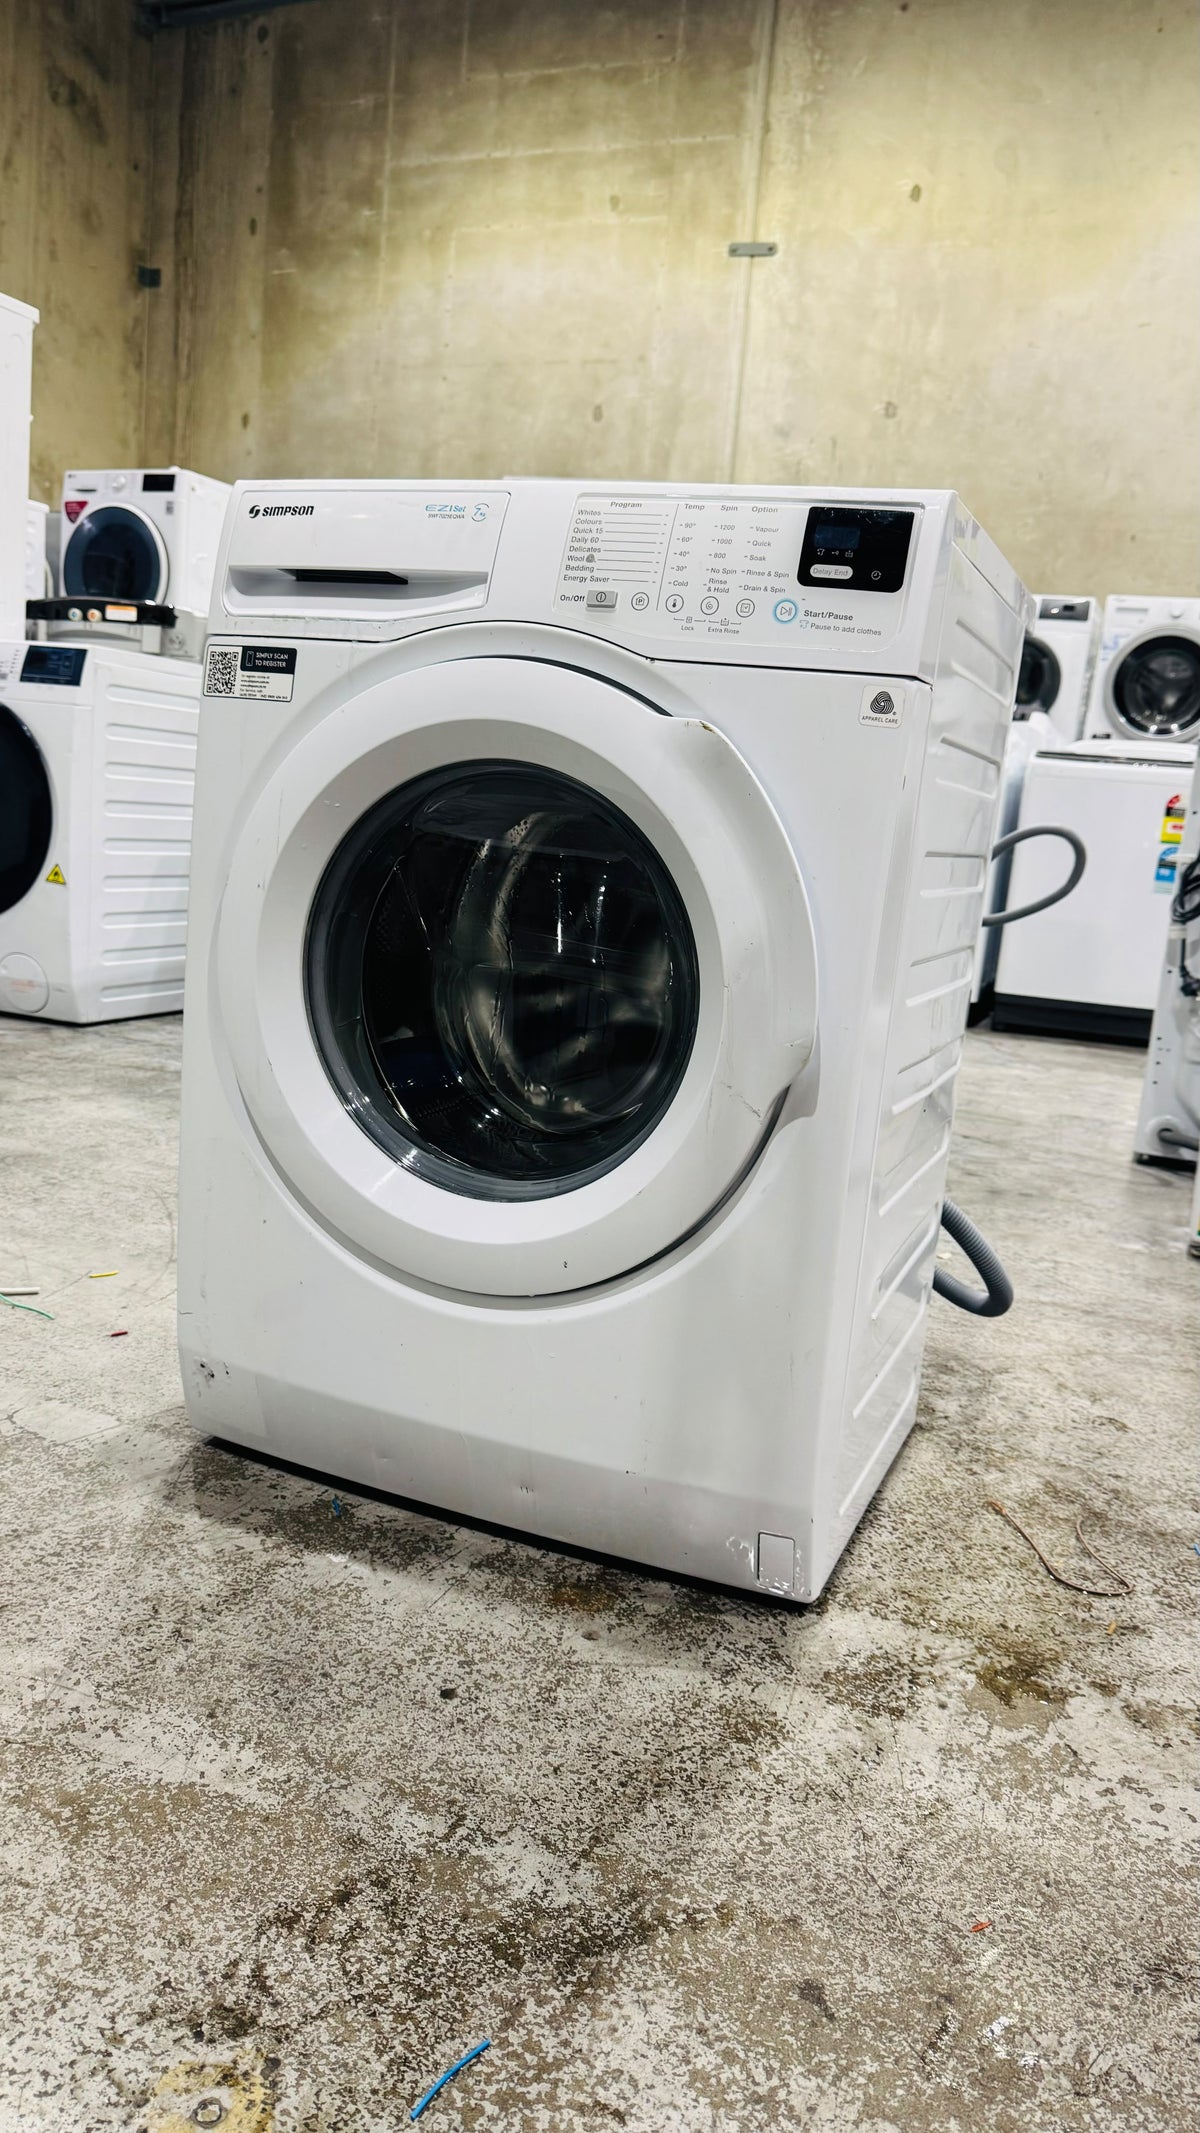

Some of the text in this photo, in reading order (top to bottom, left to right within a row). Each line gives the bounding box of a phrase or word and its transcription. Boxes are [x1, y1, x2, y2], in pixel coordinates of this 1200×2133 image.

[262, 505, 315, 517] SIMPSON
[684, 503, 705, 511] Temp
[721, 504, 738, 512] Spin
[751, 505, 778, 513] Option
[755, 525, 779, 533] Vapour
[571, 536, 589, 544] Daily
[569, 545, 601, 553] Delicates
[749, 554, 766, 562] Soak
[565, 564, 594, 573] Bedding
[721, 567, 737, 575] Spin
[812, 567, 832, 576] Delay
[746, 569, 765, 577] Rinse
[773, 571, 790, 579] Spin
[563, 574, 588, 583] Energy
[743, 584, 761, 592] Drain
[770, 586, 786, 594] Spin
[560, 594, 585, 602] On/Off
[803, 609, 854, 621] Start/Pause
[810, 622, 832, 631] Pause
[856, 627, 882, 636] clothes
[263, 660, 287, 668] REGISTER
[861, 715, 899, 725] APPAREL CARE
